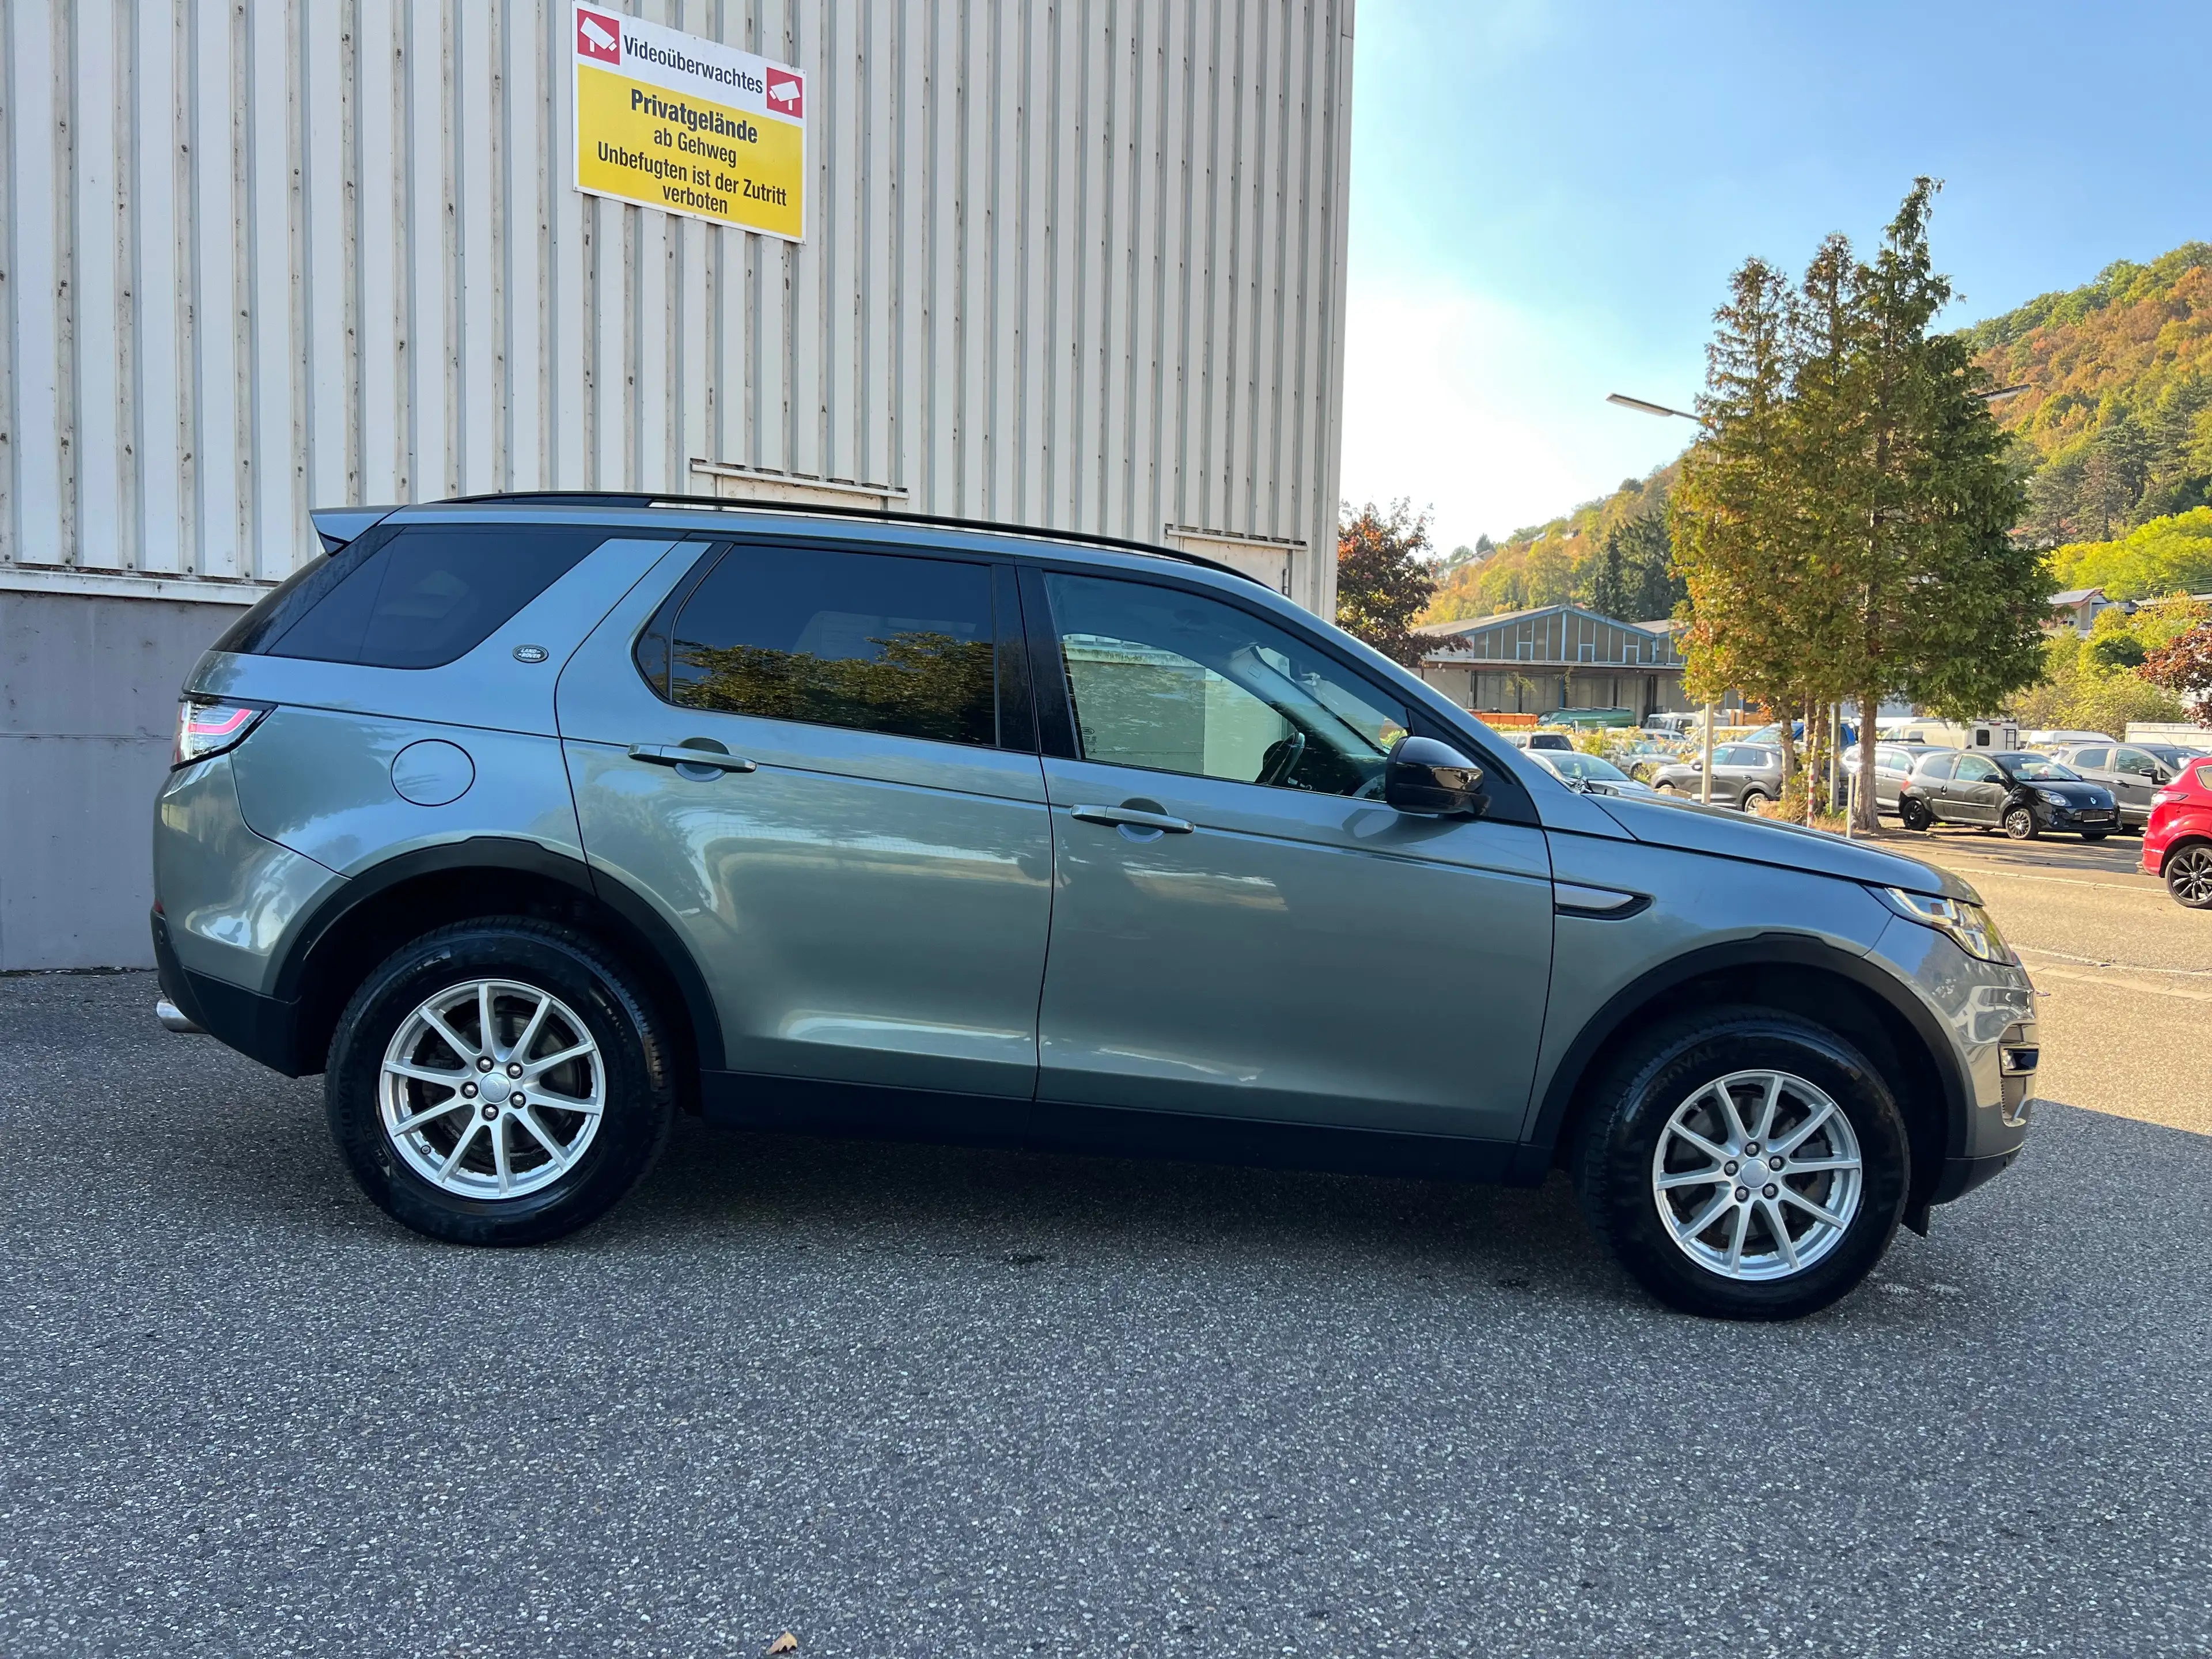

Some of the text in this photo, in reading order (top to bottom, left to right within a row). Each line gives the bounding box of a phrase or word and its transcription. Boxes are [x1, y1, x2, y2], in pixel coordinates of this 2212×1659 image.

[623, 35, 763, 94] Videoüberwachtes
[631, 88, 758, 143] Privatgelände
[598, 141, 787, 206] Unbefugten ist der Zutritt
[654, 128, 737, 168] ab Gehweg
[663, 185, 728, 214] verboten
